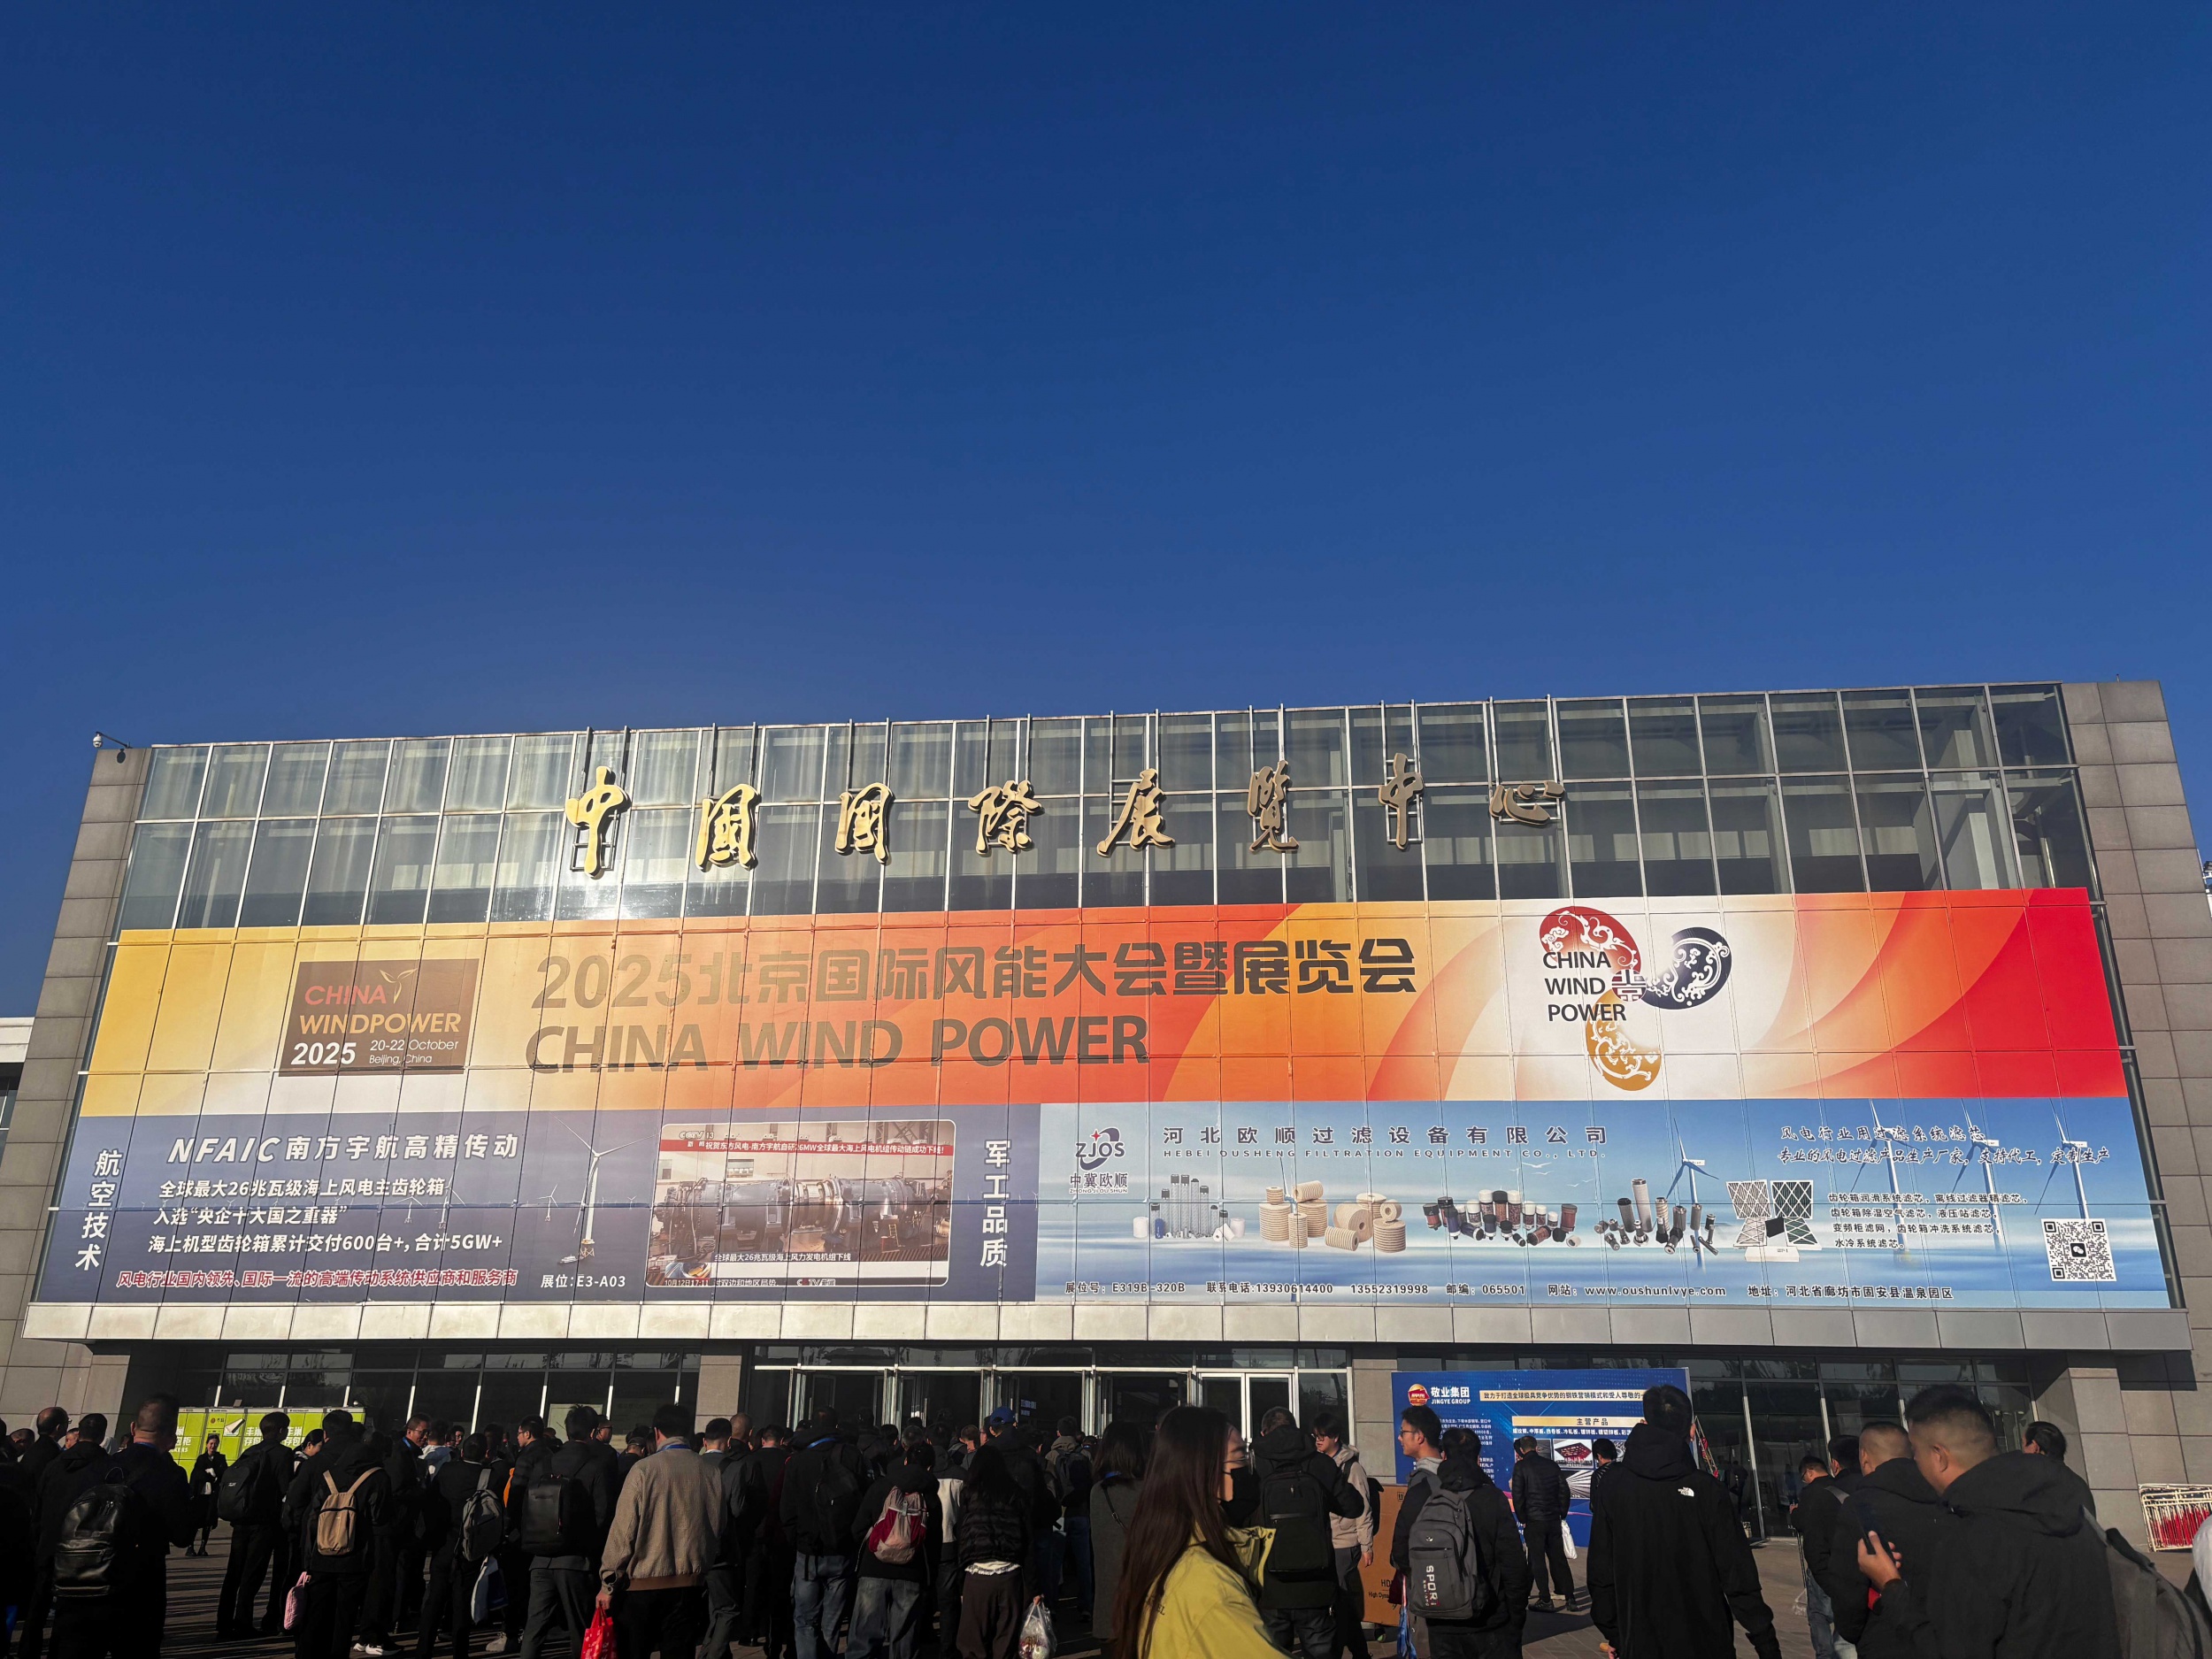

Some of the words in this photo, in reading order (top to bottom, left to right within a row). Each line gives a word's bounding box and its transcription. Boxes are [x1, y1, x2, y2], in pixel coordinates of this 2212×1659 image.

[1542, 951, 1611, 969] CHINA
[532, 938, 1417, 1010] 2025北京国际风能大会暨展览会
[304, 985, 387, 1005] CHINA
[1545, 978, 1606, 995] WIND
[1548, 1003, 1626, 1022] POWER
[300, 1013, 461, 1034] WINDPOWER
[291, 1042, 357, 1065] 2025
[370, 1040, 405, 1051] 20-22
[409, 1039, 458, 1051] October
[526, 1021, 709, 1073] CHINA
[741, 1019, 902, 1069] WIND
[932, 1015, 1149, 1066] POWER
[369, 1055, 401, 1065] Beijing,
[404, 1054, 432, 1064] China
[1163, 1125, 1607, 1145] 河北欧顺过滤设备有限公司
[1781, 1125, 1985, 1141] 风电行业用过滤系统滤芯
[167, 1137, 281, 1164] NFAIC
[285, 1133, 518, 1162] 南方宇航高精传动
[1076, 1142, 1125, 1157] ZJOS
[1522, 1149, 1557, 1158] CO.,
[158, 1179, 445, 1198] 全球最大26兆瓦级海上风电主齿轮箱
[1070, 1172, 1128, 1188] 中冀欧顺
[75, 1149, 123, 1271] 航空技术
[979, 1140, 1010, 1268] 军工品质
[1351, 1284, 1428, 1294] 13552319998
[1431, 1386, 1470, 1398] 敬业集团
